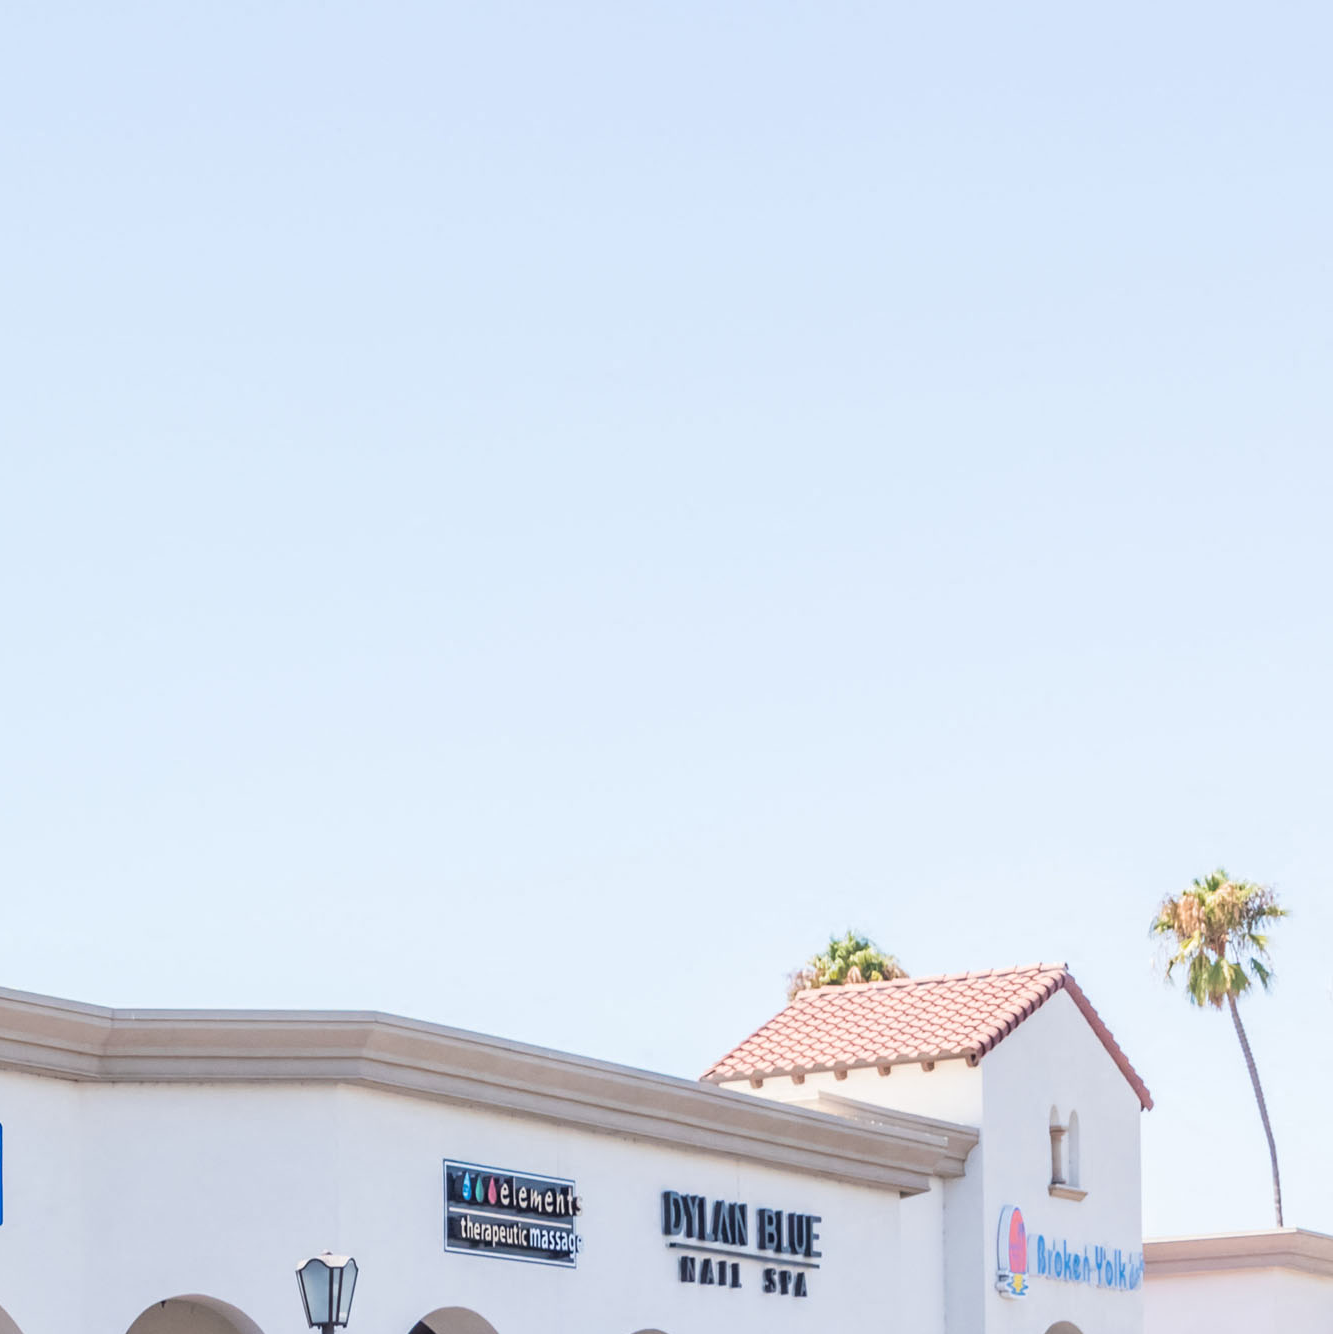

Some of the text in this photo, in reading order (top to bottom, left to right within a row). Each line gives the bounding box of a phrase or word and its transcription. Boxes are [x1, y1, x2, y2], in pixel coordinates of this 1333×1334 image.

[500, 1175, 583, 1217] elements
[460, 1214, 584, 1259] therapeutic massage
[661, 1190, 823, 1259] DYLAN BLUE
[679, 1255, 809, 1298] NAIL SPA
[1037, 1234, 1091, 1284] Broken
[1094, 1245, 1127, 1289] Yolk
